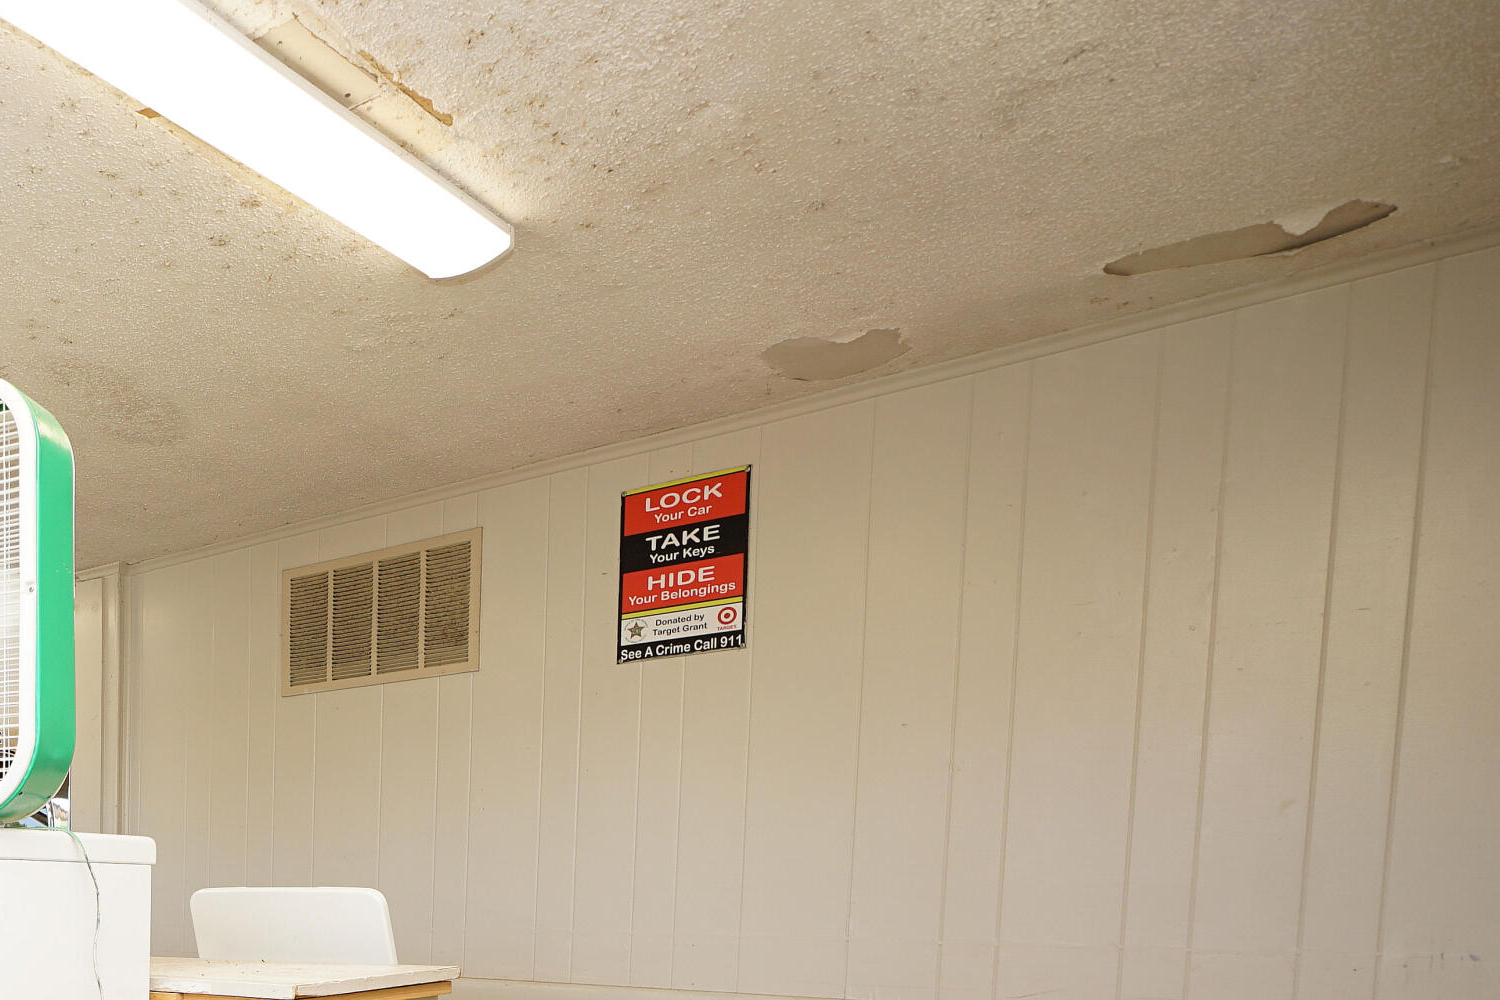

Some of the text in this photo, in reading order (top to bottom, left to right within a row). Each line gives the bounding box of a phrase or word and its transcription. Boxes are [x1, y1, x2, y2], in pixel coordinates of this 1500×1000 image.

[645, 482, 723, 513] LOCK
[654, 504, 713, 524] Your Car
[645, 524, 721, 551] TAKE
[649, 544, 715, 564] Your Keys
[646, 565, 716, 591] HIDE
[628, 580, 736, 607] Your Belongings
[652, 625, 681, 638] Target
[682, 622, 708, 634] Grant
[655, 613, 705, 627] Donated by
[620, 634, 742, 661] See A Crime Call 911
